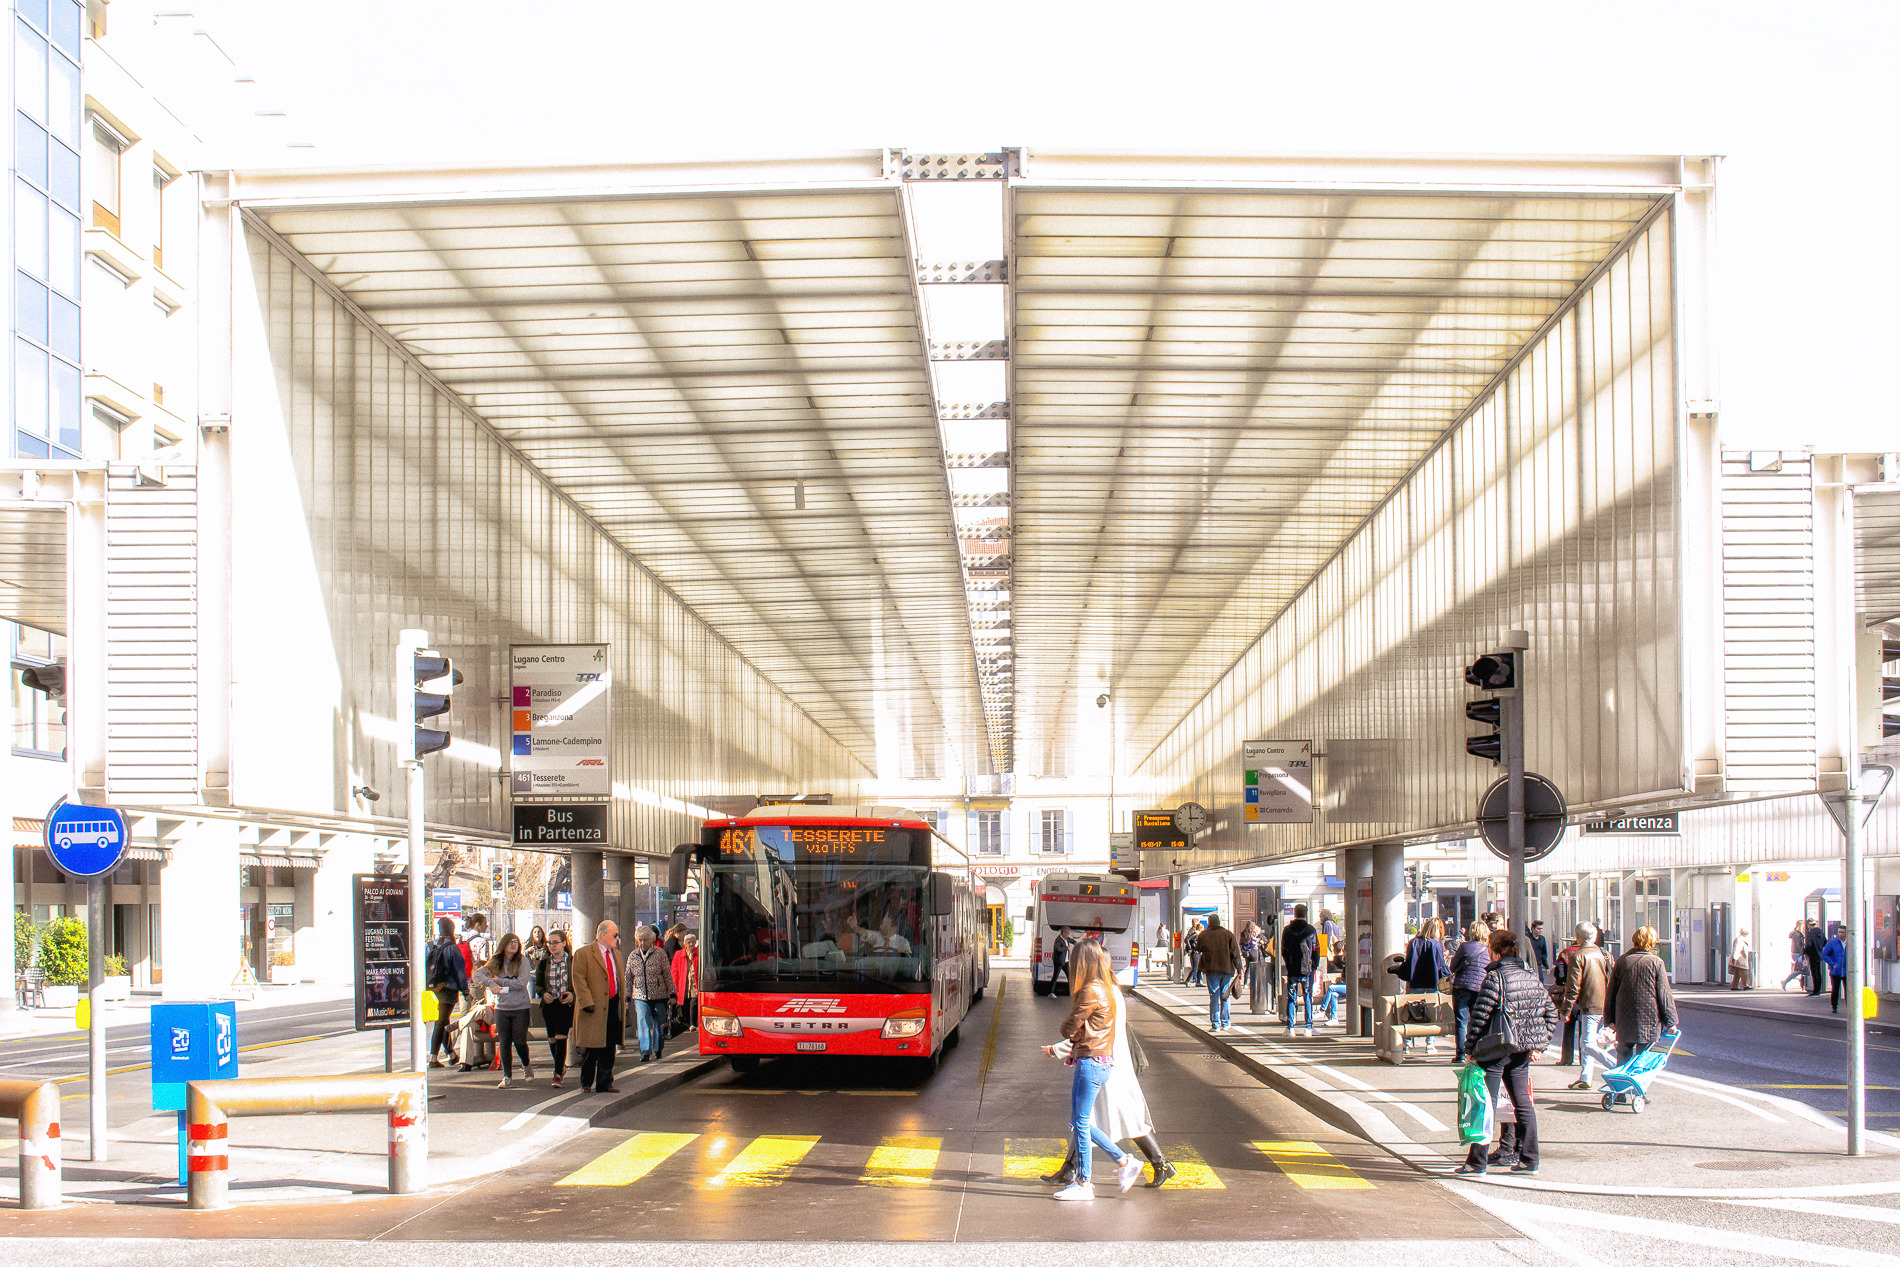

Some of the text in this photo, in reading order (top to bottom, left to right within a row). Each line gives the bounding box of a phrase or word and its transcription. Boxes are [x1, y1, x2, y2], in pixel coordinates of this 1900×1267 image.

[514, 655, 565, 665] Lugano Centro
[575, 673, 604, 682] TPL
[525, 689, 562, 697] 2 Paradiso
[526, 713, 574, 722] 3 Breganzona
[525, 737, 602, 746] 5 Lamone-Cadempino
[517, 773, 566, 782] 461 Tesserete
[547, 809, 573, 823] Bus
[1609, 816, 1673, 829] Partenza
[519, 825, 601, 840] in Partenza
[720, 829, 886, 854] 461 TESSERETE
[806, 841, 856, 853] via FFS
[385, 888, 404, 896] GIOVANI
[1087, 885, 1093, 894] 7
[365, 935, 385, 943] FESTIVAL
[393, 967, 405, 975] MOVE
[775, 998, 848, 1013] ARL
